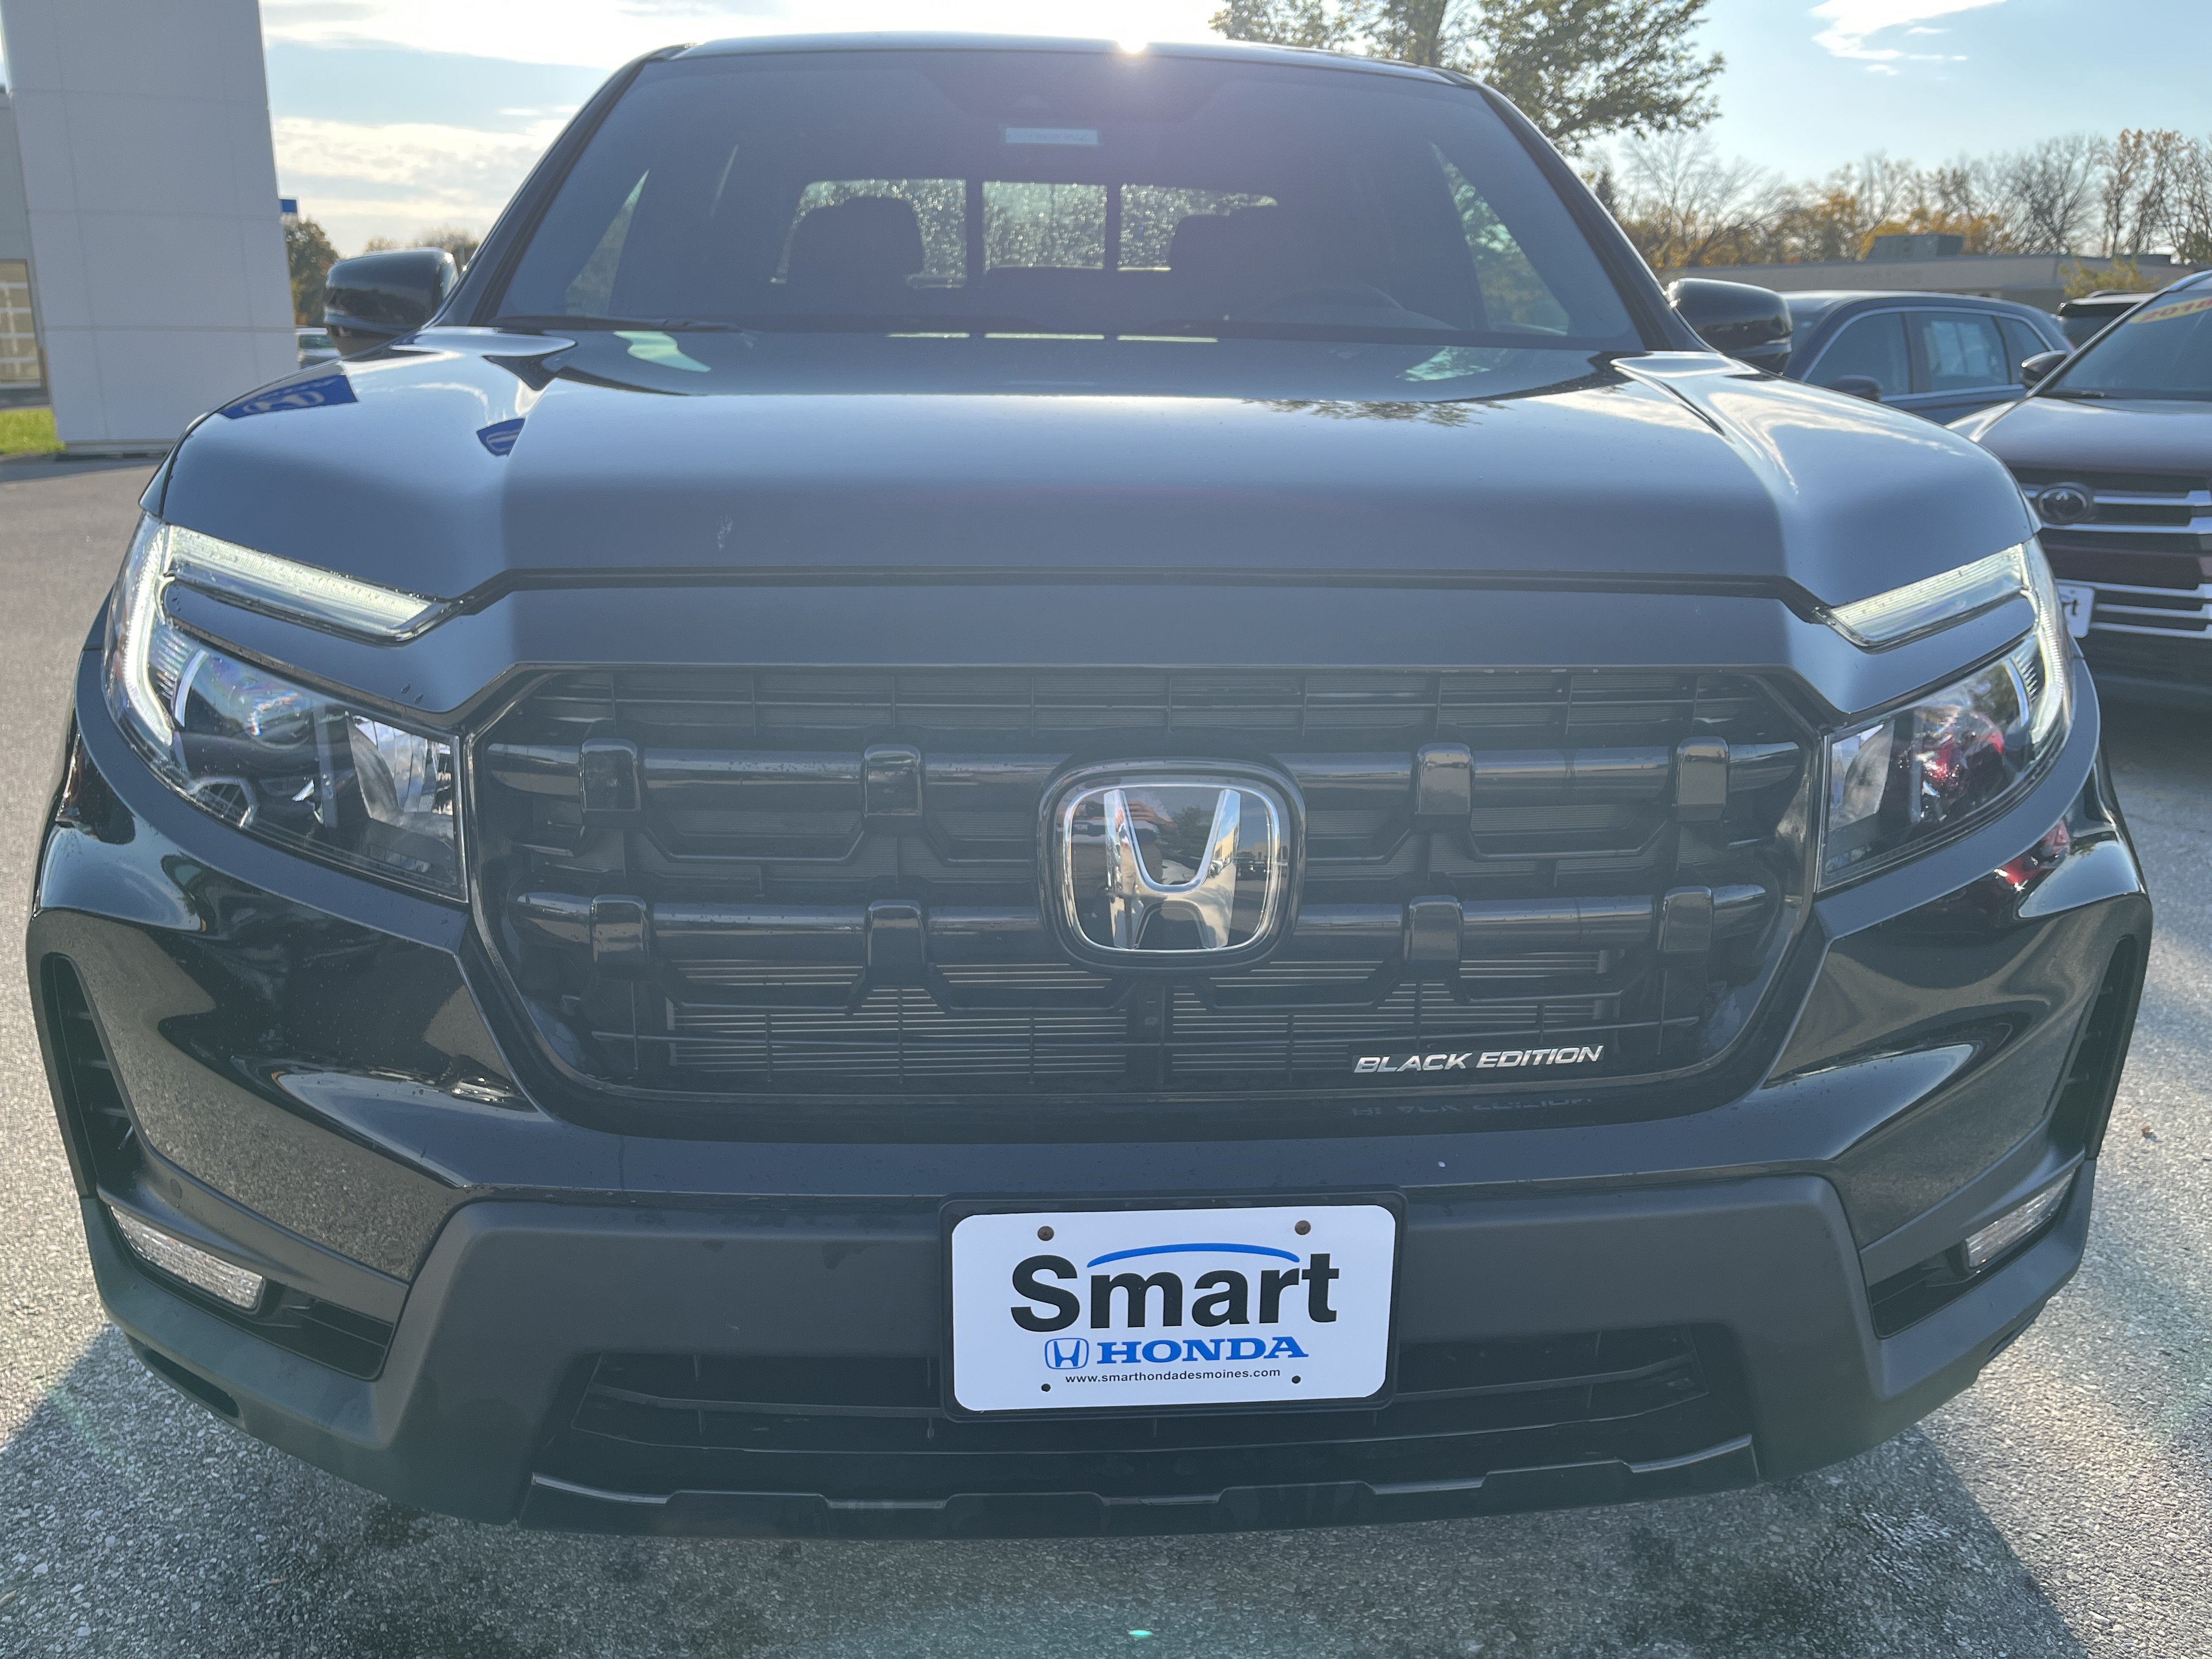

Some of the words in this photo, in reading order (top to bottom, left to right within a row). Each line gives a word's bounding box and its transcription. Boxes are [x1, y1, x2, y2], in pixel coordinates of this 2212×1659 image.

[1354, 1052, 1473, 1073] BLACK
[1476, 1045, 1604, 1068] EDITION
[1011, 1253, 1339, 1332] Smart
[1097, 1336, 1309, 1364] HONDA
[1065, 1369, 1281, 1383] www.smarthondadesmoines.com
